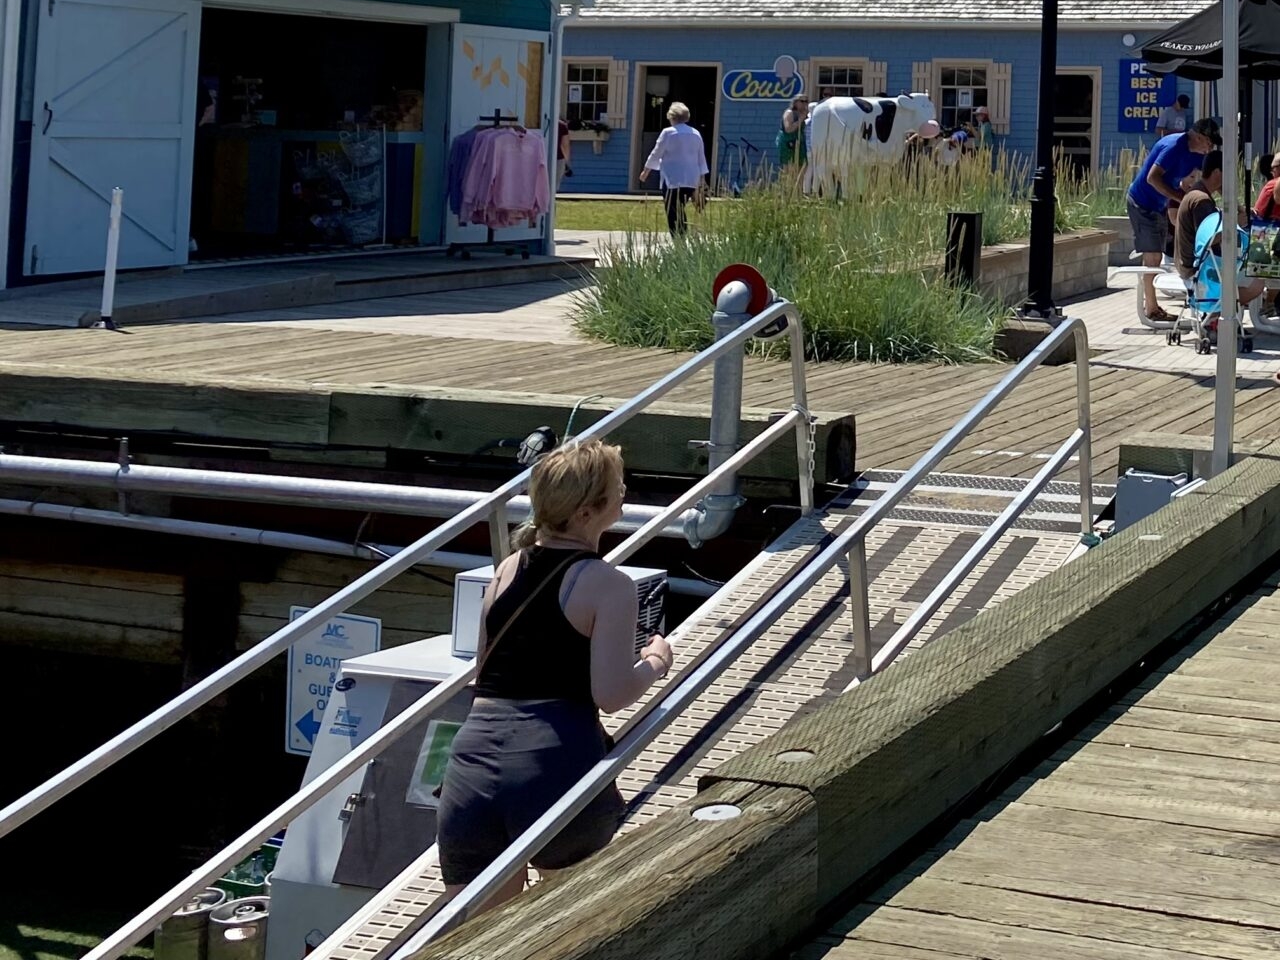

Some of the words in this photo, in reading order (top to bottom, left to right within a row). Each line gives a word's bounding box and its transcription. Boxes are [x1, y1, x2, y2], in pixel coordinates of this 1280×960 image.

[1160, 41, 1192, 51] PEAKES
[1130, 63, 1150, 74] PE
[1131, 78, 1163, 89] BEST
[1136, 92, 1157, 103] ICE
[329, 672, 336, 683] &
